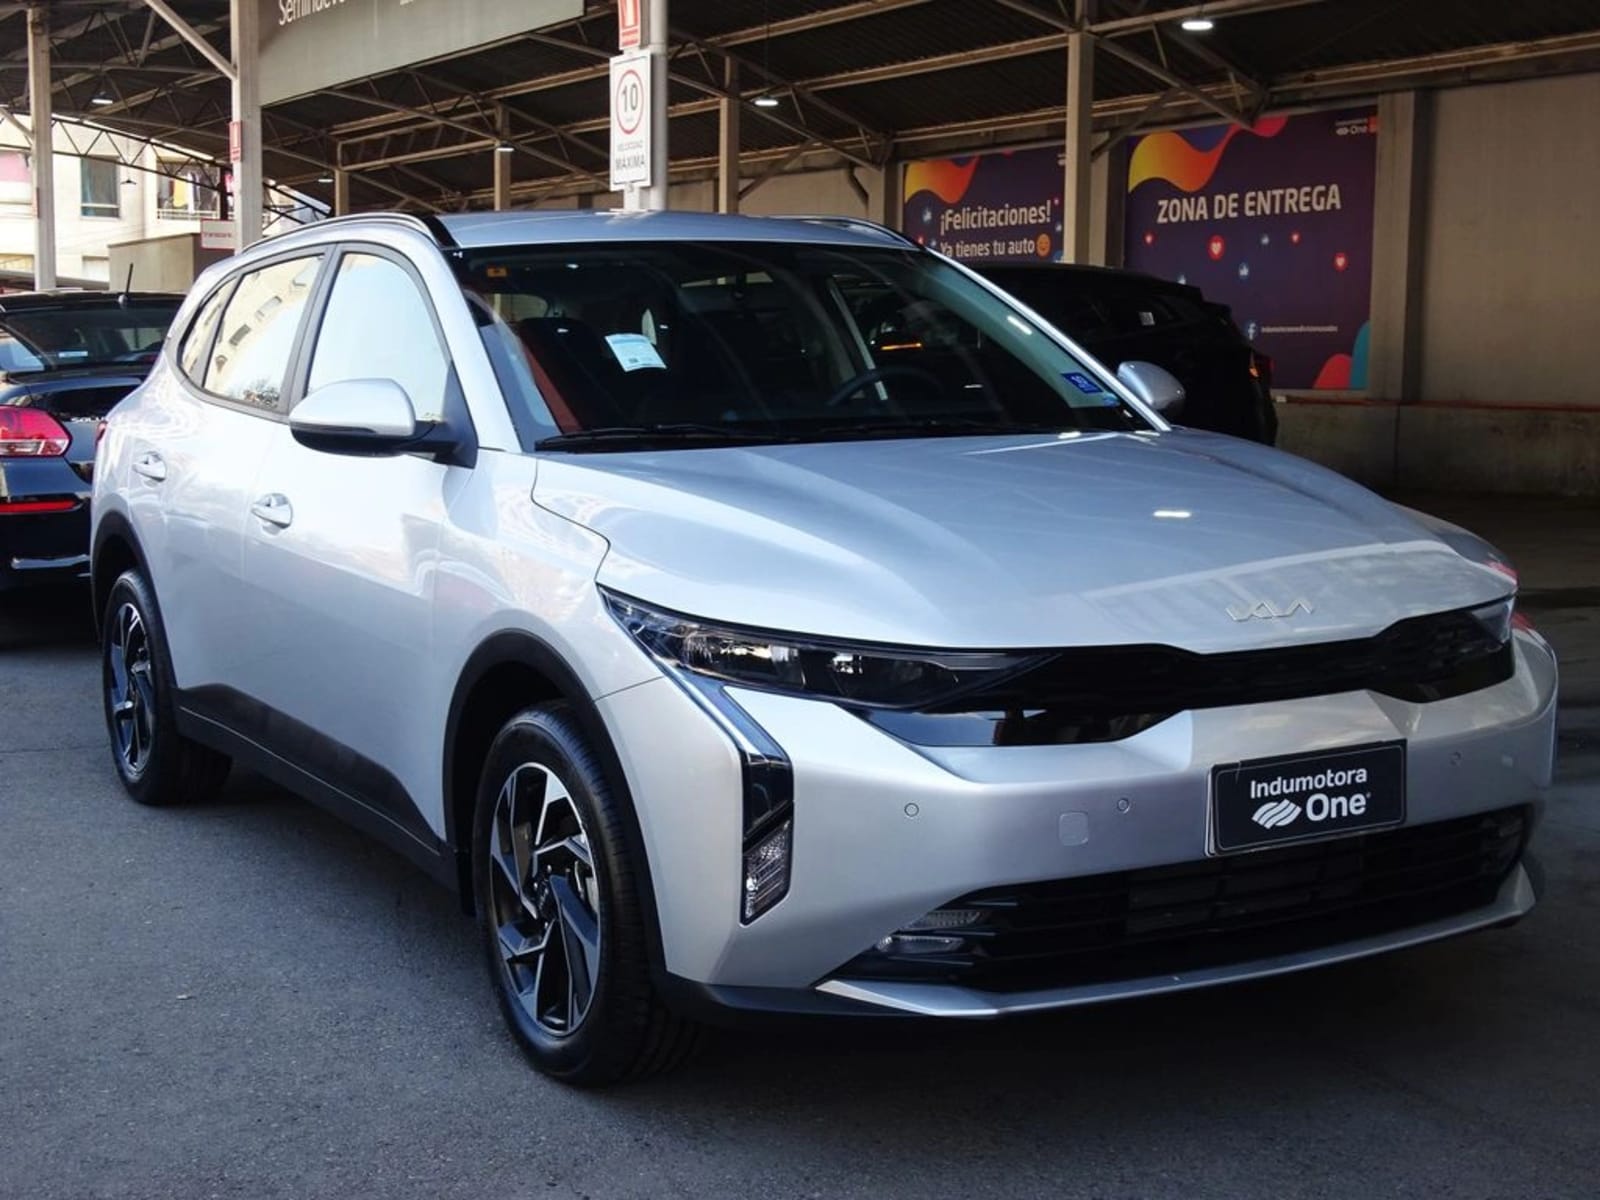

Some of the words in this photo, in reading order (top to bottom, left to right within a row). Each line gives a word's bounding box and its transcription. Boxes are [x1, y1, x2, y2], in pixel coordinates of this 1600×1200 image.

[622, 83, 638, 113] 10
[940, 200, 1051, 235] ¡Felicitaciones!
[1156, 196, 1208, 224] ZONA
[1213, 192, 1239, 219] DE
[1244, 183, 1342, 217] ENTREGA
[956, 241, 989, 257] tienes
[992, 239, 1006, 255] tu
[1008, 238, 1035, 254] auto
[1250, 767, 1368, 799] Indumotora
